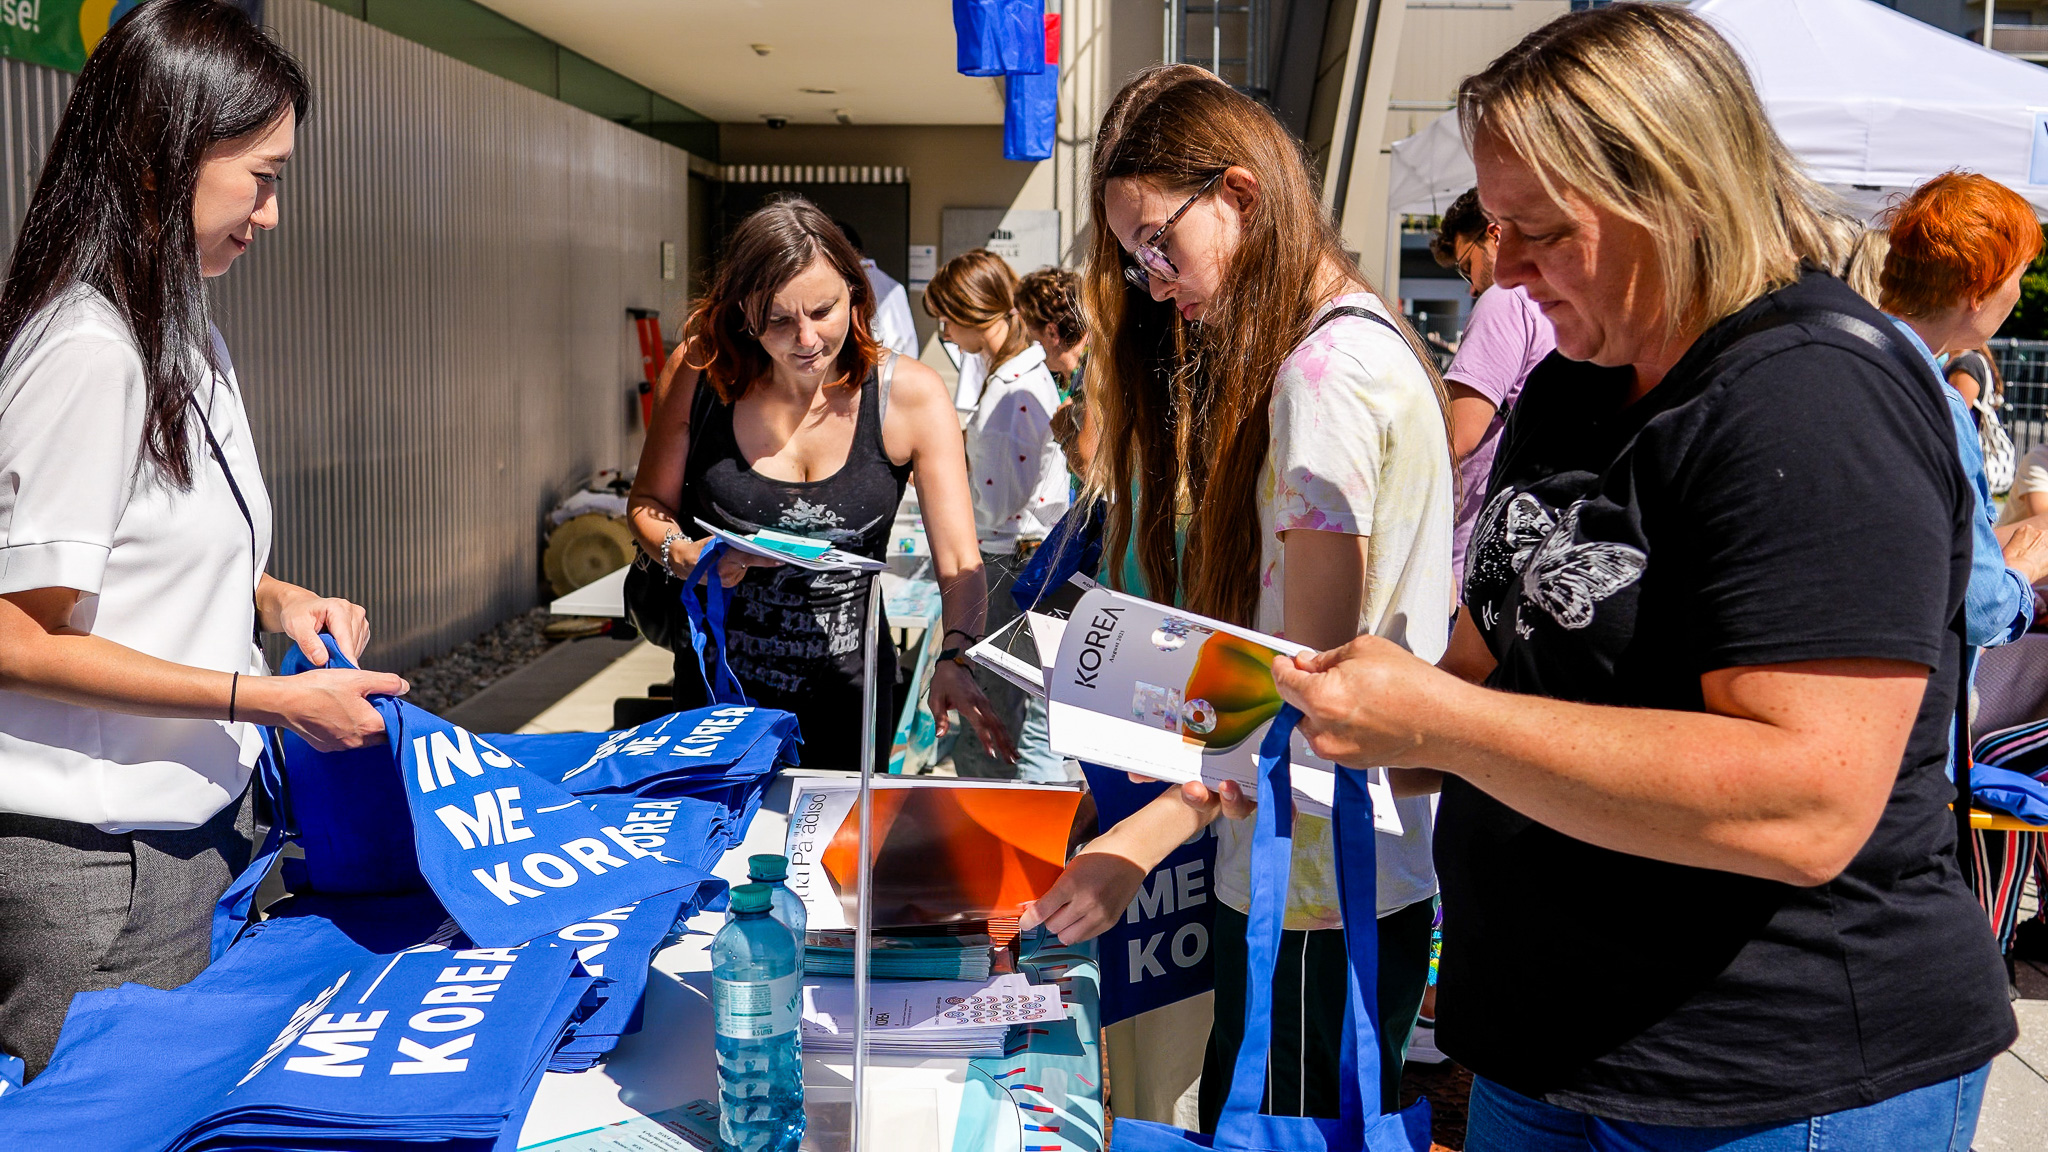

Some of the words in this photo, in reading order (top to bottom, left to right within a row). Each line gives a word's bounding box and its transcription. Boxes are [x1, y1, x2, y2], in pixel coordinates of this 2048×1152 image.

[0, 0, 39, 33] se!
[1109, 643, 1119, 663] August
[413, 726, 525, 794] INS
[669, 707, 755, 757] KOREA
[435, 786, 535, 850] ME
[792, 794, 827, 865] Paadiso
[1127, 859, 1206, 923] ME
[1128, 922, 1208, 983] KO
[389, 941, 530, 1075] KOREA
[284, 1010, 390, 1077] ME
